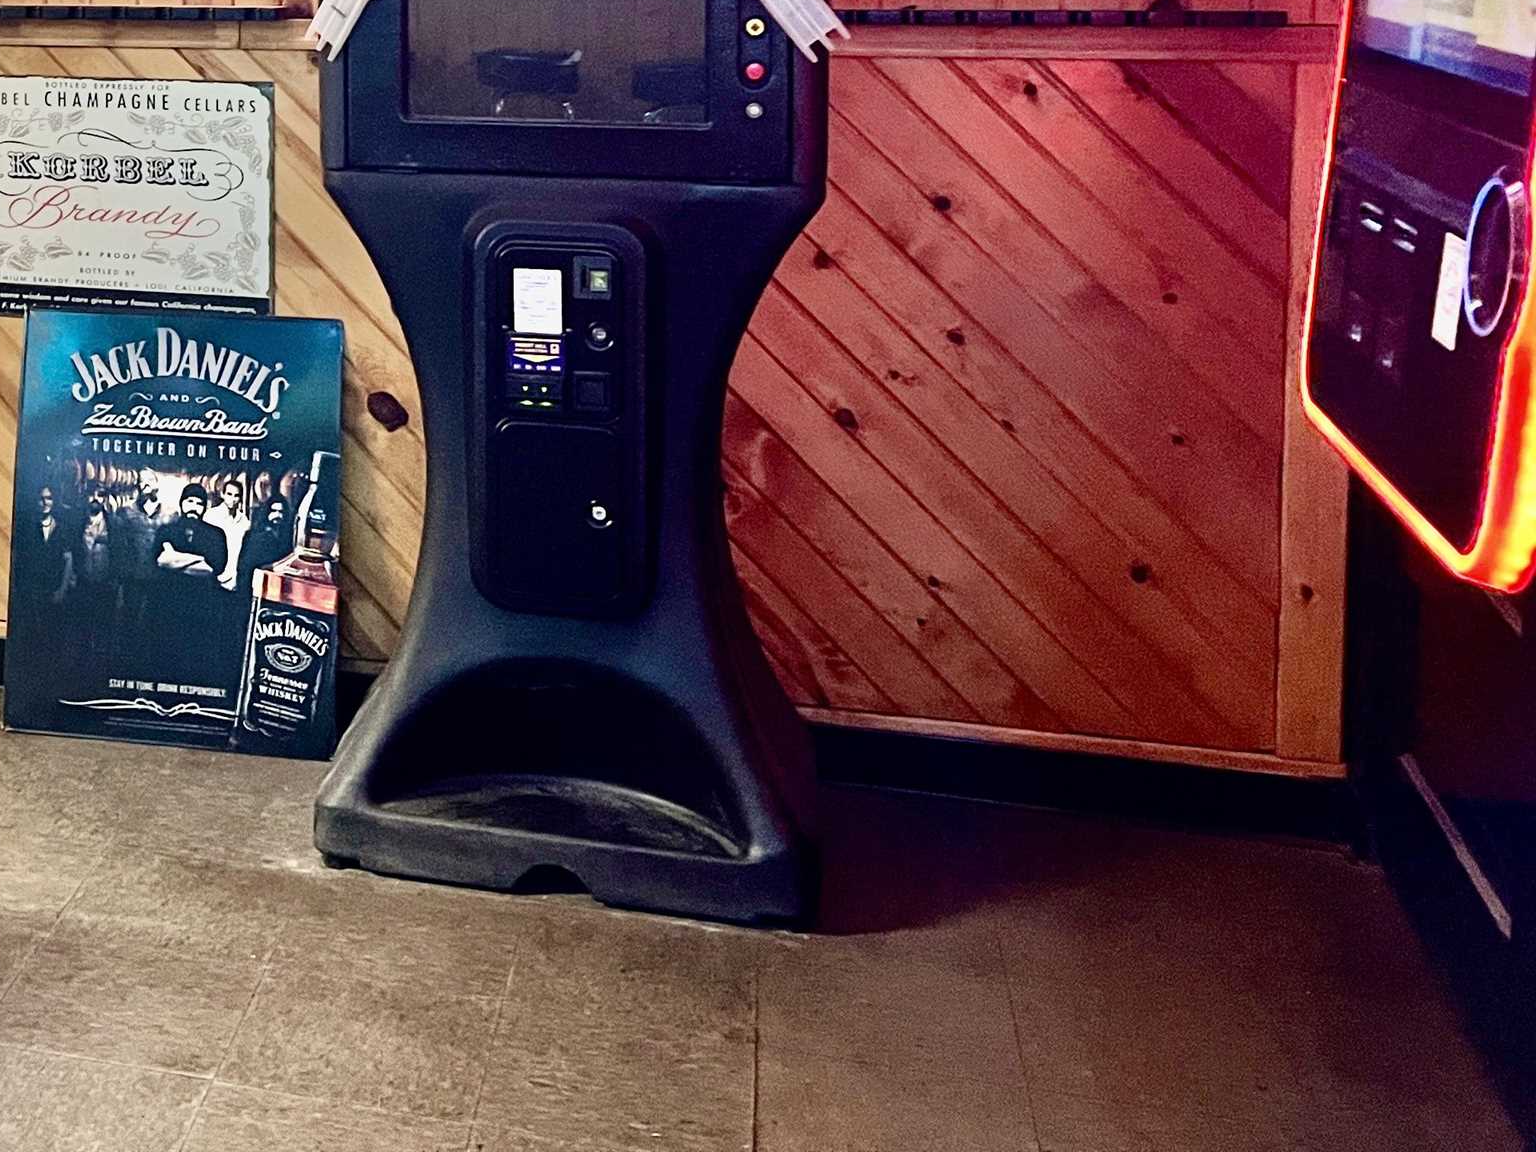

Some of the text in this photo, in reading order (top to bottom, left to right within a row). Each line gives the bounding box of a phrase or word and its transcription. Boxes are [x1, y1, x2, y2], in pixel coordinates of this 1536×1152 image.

[44, 91, 170, 111] CHAMPAGNE
[184, 97, 257, 113] CELLARS
[7, 150, 209, 187] KORBEL
[69, 326, 292, 415] JACK DANIEL'S
[159, 393, 191, 403] AND
[92, 436, 261, 462] TOGETHER ON TOUR
[255, 621, 284, 641] JACK
[258, 685, 306, 704] WHISKEY
